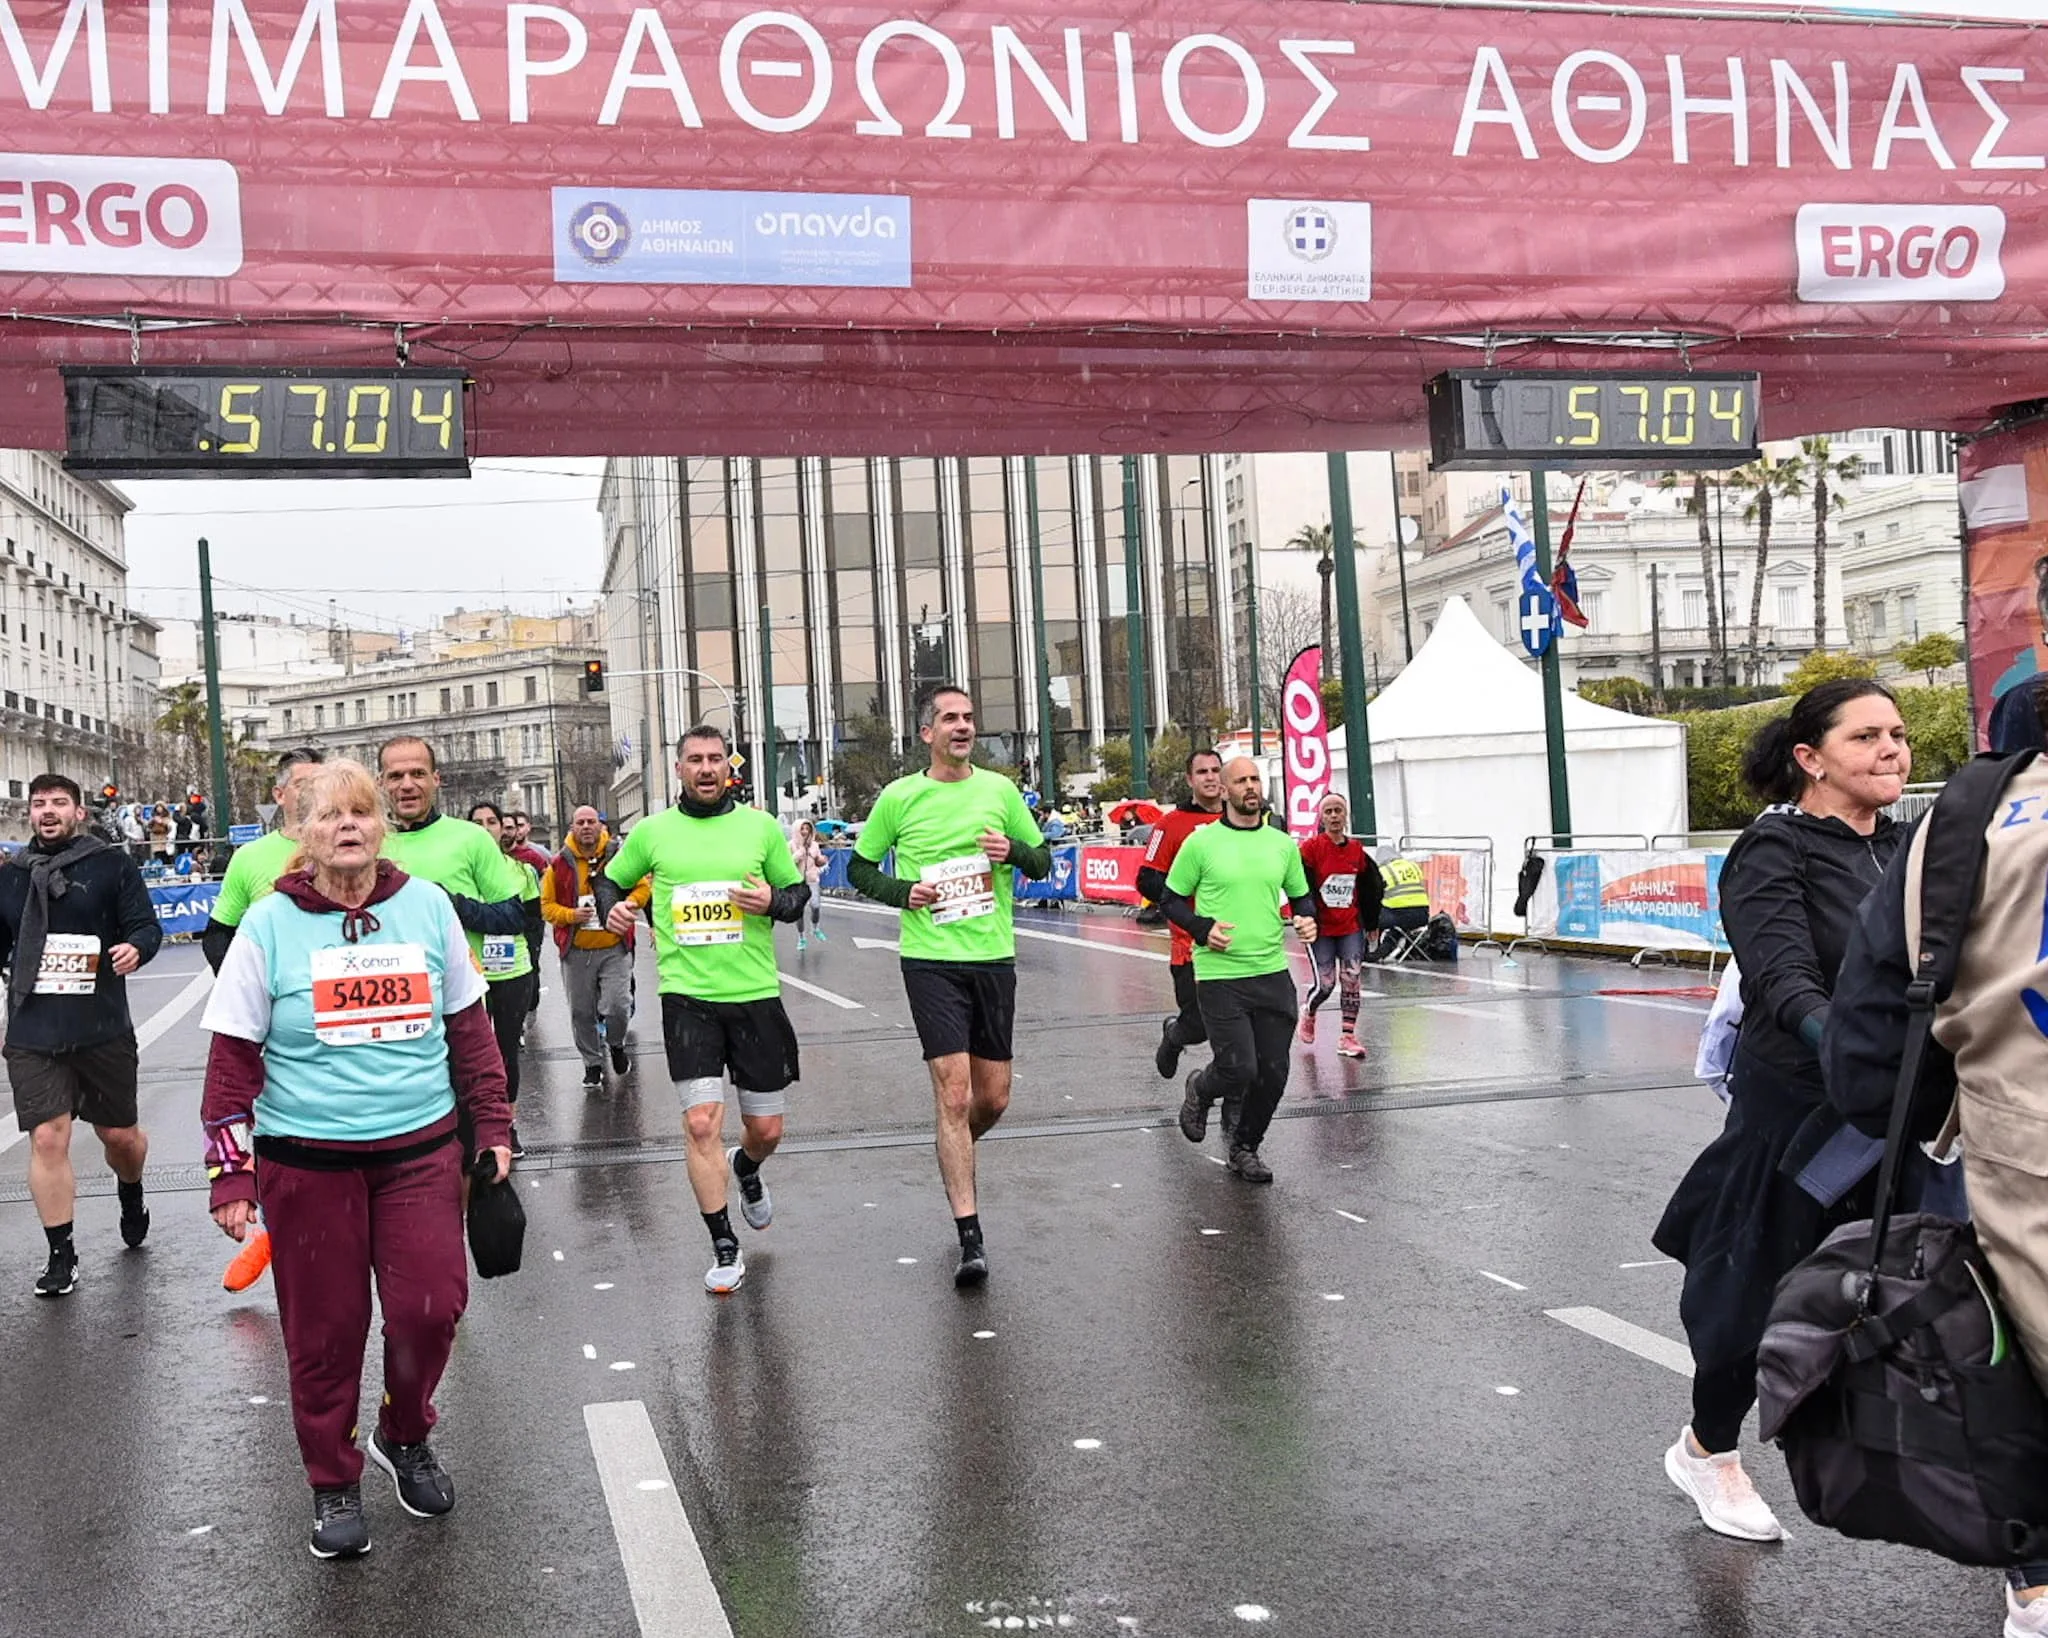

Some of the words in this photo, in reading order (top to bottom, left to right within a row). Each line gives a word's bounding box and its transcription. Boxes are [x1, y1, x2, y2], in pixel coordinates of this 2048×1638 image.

[1452, 46, 2046, 171] ΑΘΗΝΑΣ
[640, 219, 703, 235] ΔΗΜΟΣ
[640, 238, 734, 255] ΑΘΗΝΑΙΩΝ
[1821, 225, 1980, 280] ERGO
[1285, 678, 1328, 840] RGO
[1086, 858, 1119, 881] ERGO
[1629, 880, 1677, 897] ΑΘΗΝΑΣ
[683, 903, 732, 922] 51095
[332, 976, 413, 1009] 54283
